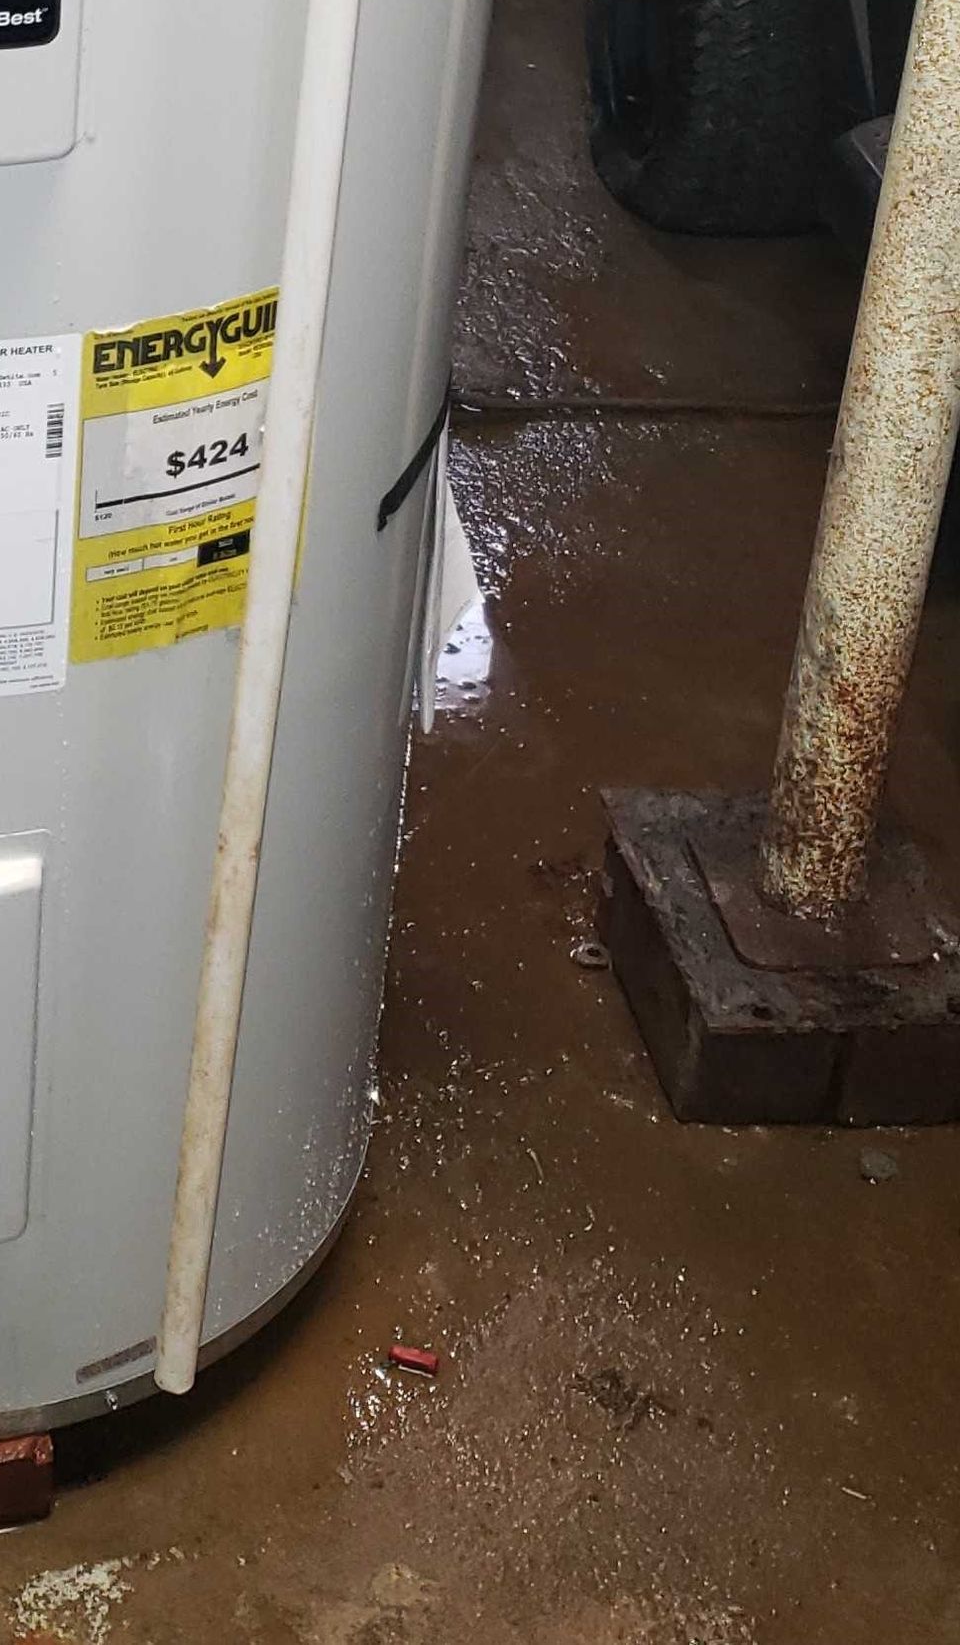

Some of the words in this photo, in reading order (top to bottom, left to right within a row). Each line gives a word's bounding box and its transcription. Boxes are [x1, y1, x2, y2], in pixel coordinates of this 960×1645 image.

[10, 344, 53, 355] HEATER
[153, 408, 190, 424] Estimated
[192, 404, 214, 417] Yearly
[216, 397, 240, 411] Energy
[241, 390, 258, 401] Cost
[166, 432, 248, 479] $424
[168, 524, 186, 535] First
[188, 518, 206, 530] Hour
[207, 511, 231, 525] Rating
[128, 543, 148, 554] much
[150, 541, 163, 551] hot
[164, 537, 184, 548] water
[185, 535, 197, 545] you
[199, 531, 209, 541] get
[210, 528, 216, 536] in
[217, 524, 229, 533] the
